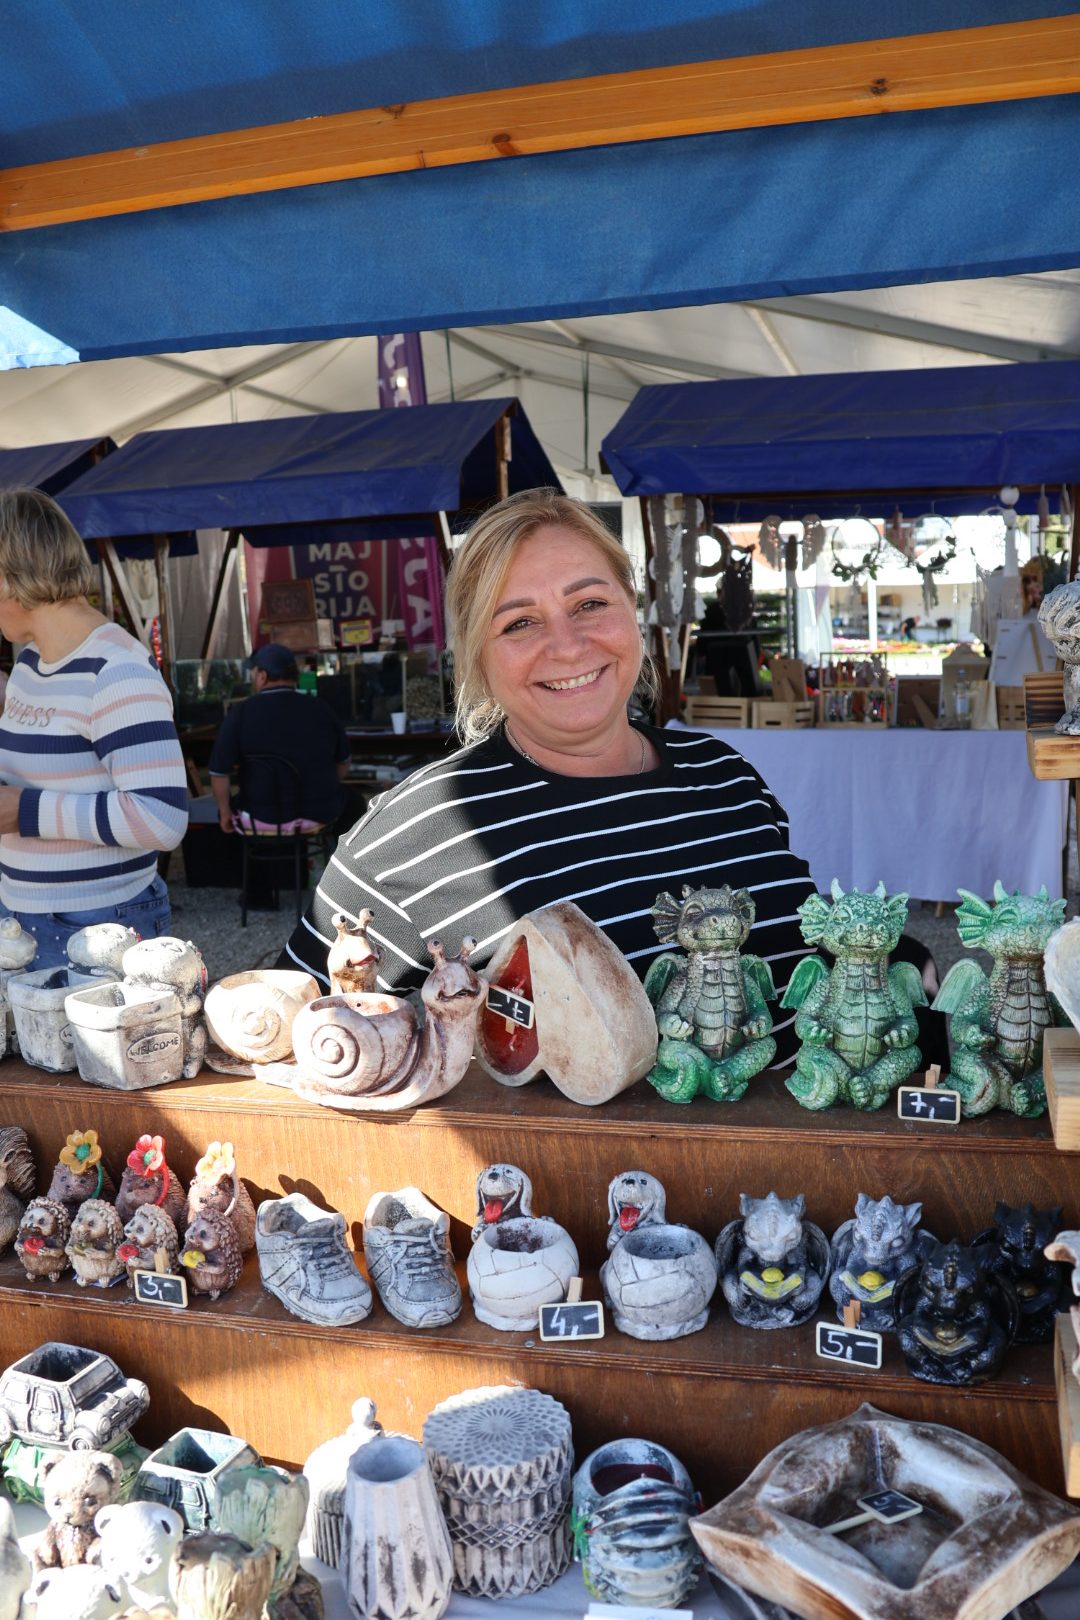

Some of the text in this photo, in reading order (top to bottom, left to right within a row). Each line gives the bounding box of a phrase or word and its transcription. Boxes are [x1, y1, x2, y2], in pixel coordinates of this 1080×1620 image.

[129, 1037, 179, 1057] WELCOME
[141, 1275, 177, 1300] 3,-
[550, 1306, 599, 1338] 4,-
[821, 1330, 879, 1360] 5,-
